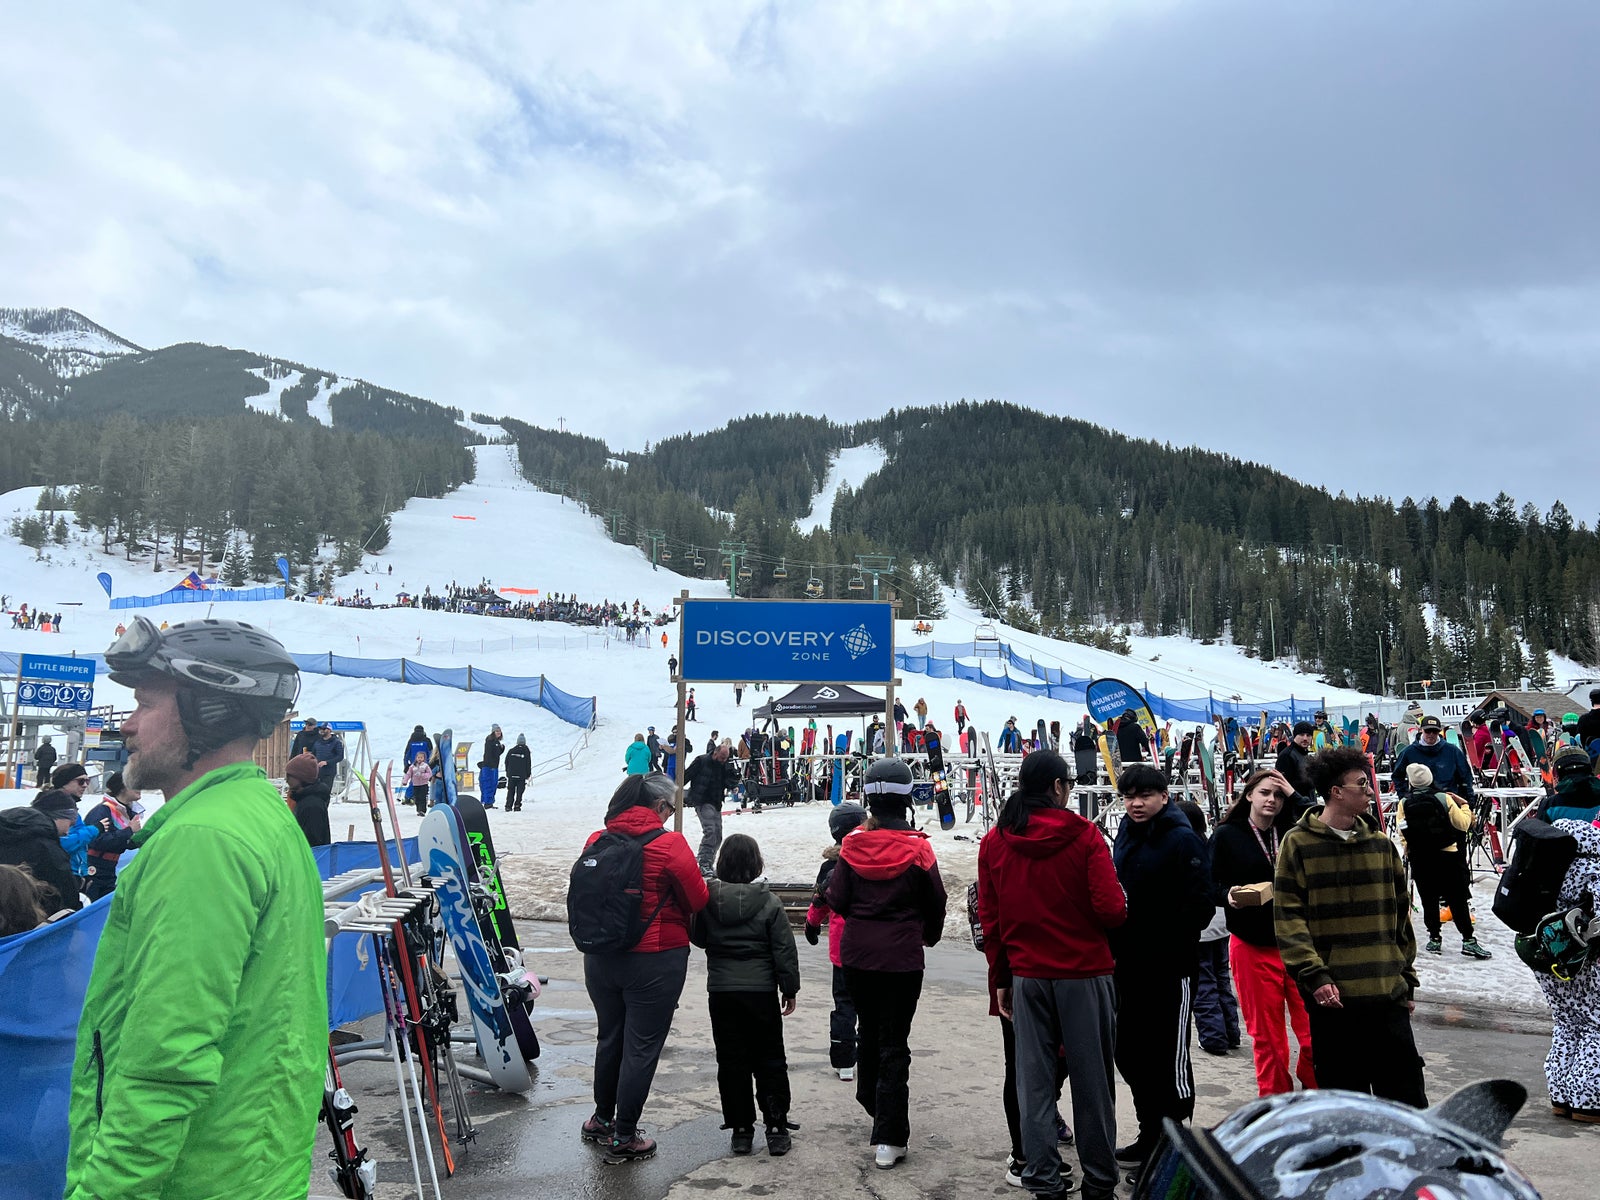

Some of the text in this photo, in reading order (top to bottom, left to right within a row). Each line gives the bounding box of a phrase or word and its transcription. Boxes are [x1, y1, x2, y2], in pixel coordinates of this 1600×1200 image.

[696, 630, 835, 647] DISCOVERY
[791, 652, 830, 661] ZONE
[29, 662, 89, 674] LITTLE RIPPER
[1091, 690, 1127, 707] MOUNTAIN
[1097, 698, 1126, 714] FRIENDS
[1442, 704, 1469, 716] MILE
